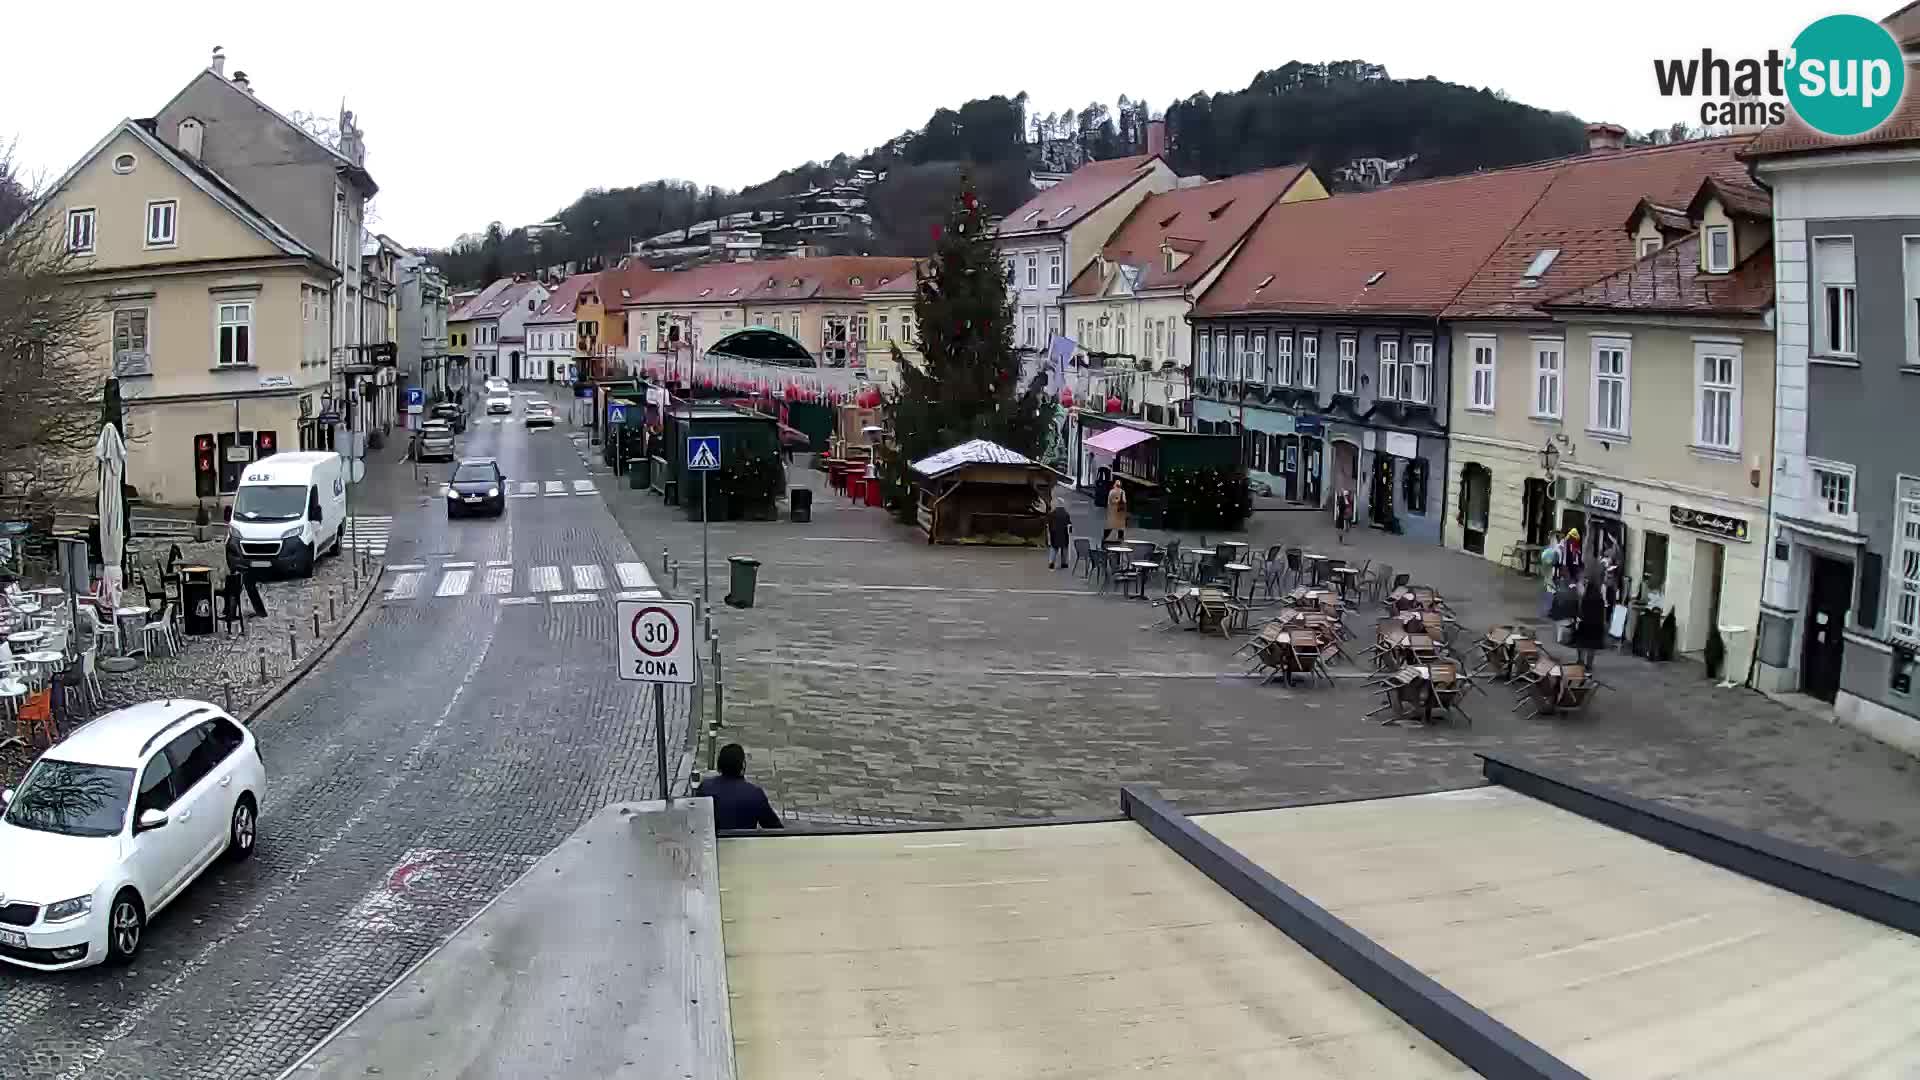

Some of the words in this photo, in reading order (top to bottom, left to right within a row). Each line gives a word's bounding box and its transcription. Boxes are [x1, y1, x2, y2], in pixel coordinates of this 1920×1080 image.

[248, 474, 272, 482] GLS
[644, 622, 668, 643] 30
[634, 659, 679, 676] ZONA
